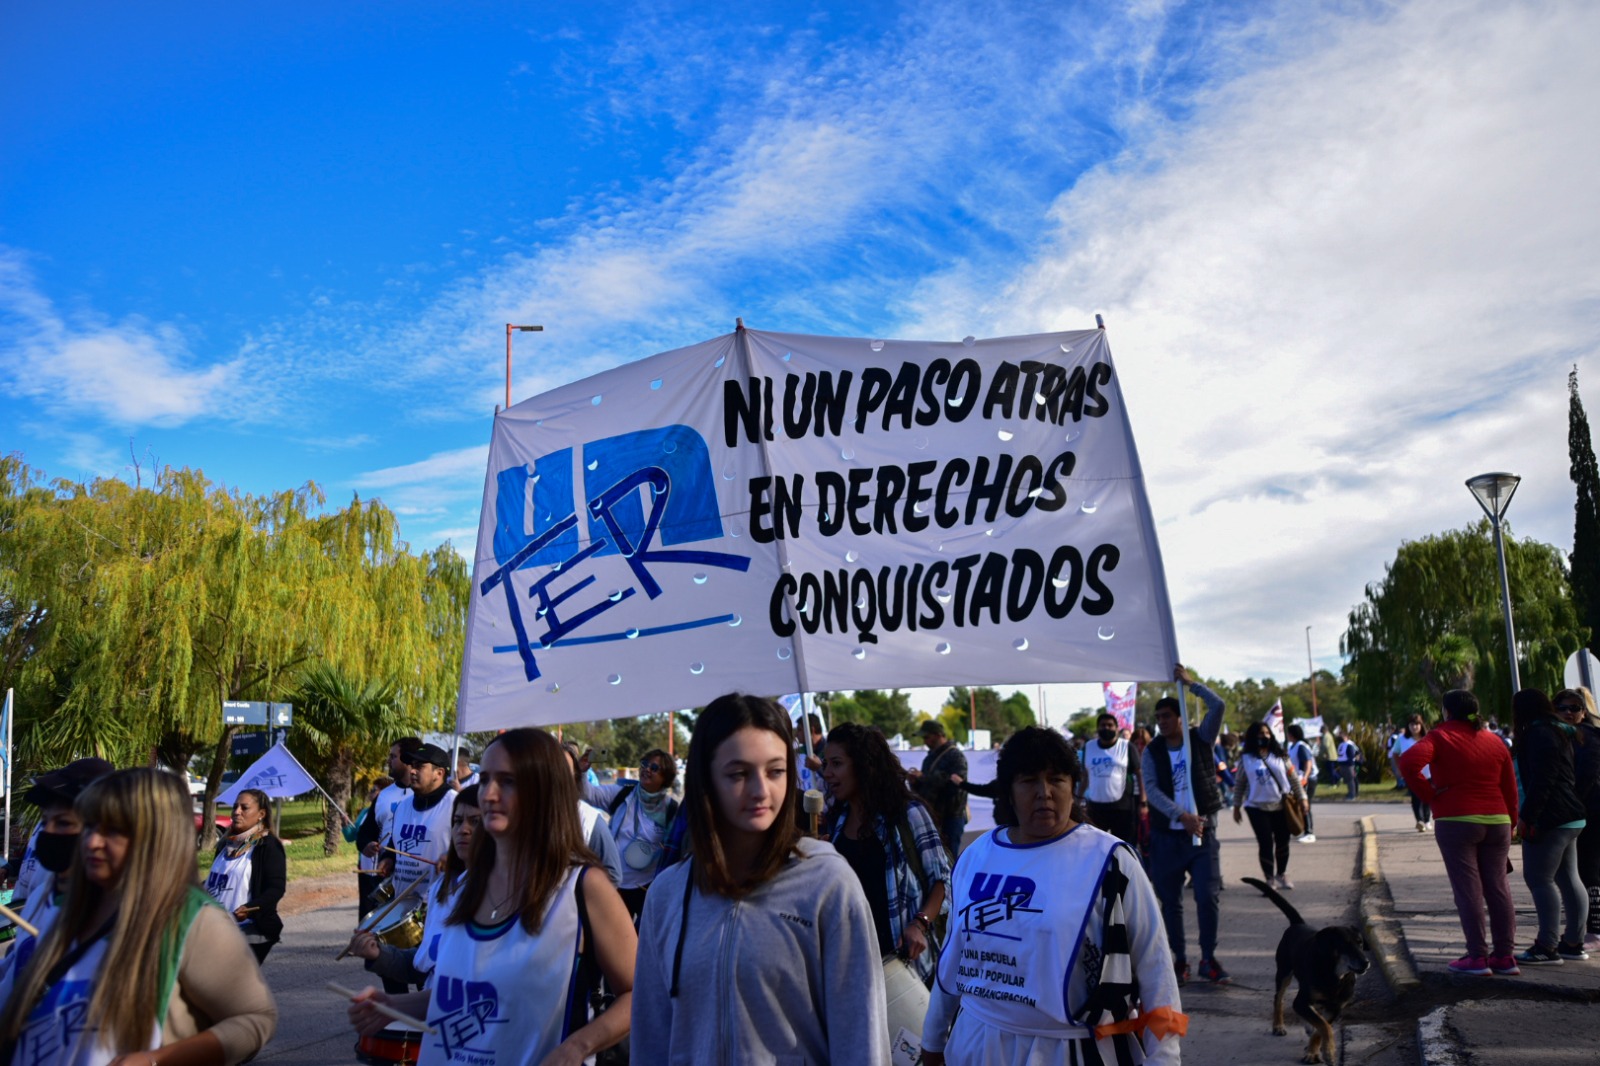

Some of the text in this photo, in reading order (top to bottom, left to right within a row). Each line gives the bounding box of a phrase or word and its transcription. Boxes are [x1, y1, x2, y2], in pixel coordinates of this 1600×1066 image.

[724, 358, 1111, 448] NI UN PASO ATRAS
[748, 451, 1076, 544] EN DERECHOS
[480, 465, 752, 683] TER
[769, 543, 1121, 645] CONQUISTADOS
[959, 892, 1043, 942] TER
[980, 951, 1017, 968] ESCUELA
[985, 969, 1025, 988] POPULAR
[428, 1000, 510, 1061] TER
